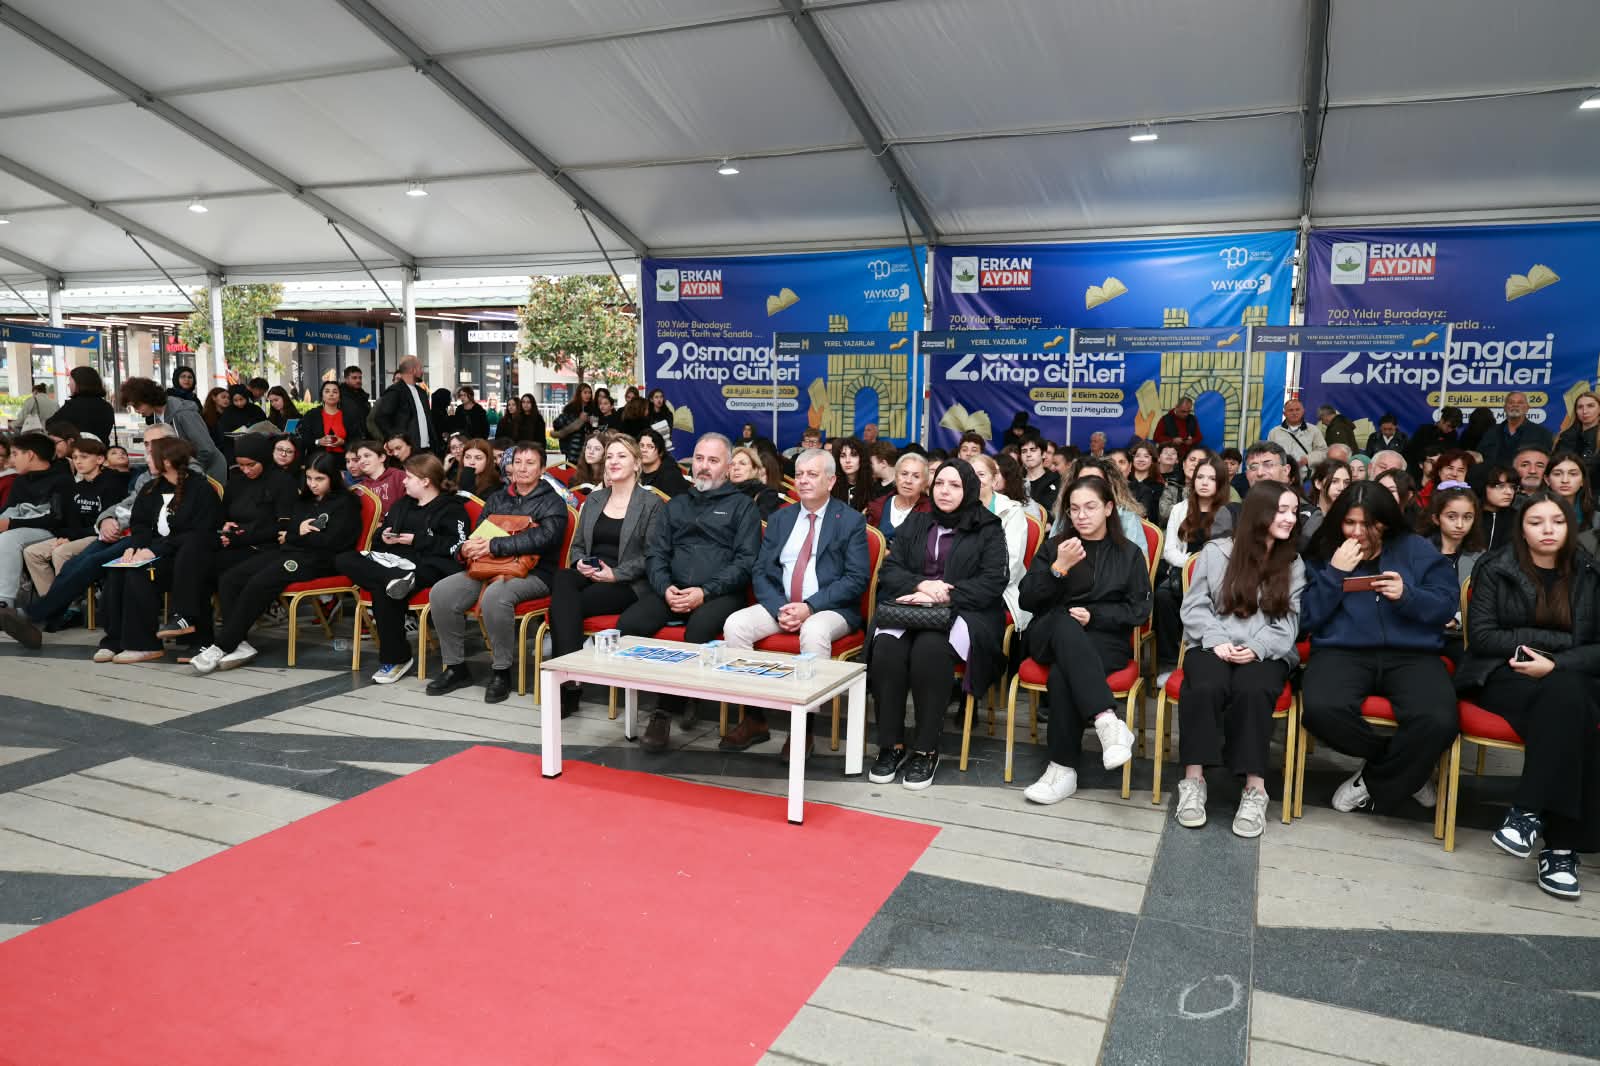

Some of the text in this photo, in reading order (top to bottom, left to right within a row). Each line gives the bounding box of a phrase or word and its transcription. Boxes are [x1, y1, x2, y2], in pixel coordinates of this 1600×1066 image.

[1370, 242, 1436, 258] ERKAN
[981, 258, 1032, 270] ERKAN
[680, 270, 722, 282] ERKAN
[982, 272, 1028, 285] AYDIN
[682, 282, 720, 294] AYDIN
[950, 315, 966, 323] 700
[1328, 309, 1446, 320] 700 Yıldır Buradayız:
[656, 342, 682, 380] 2.
[682, 342, 799, 367] Osmang
[683, 362, 800, 384] Kitap Günleri
[982, 363, 1125, 386] Kitap Günleri
[1366, 362, 1552, 390] Kitap Günleri
[1448, 396, 1472, 405] Eylül
